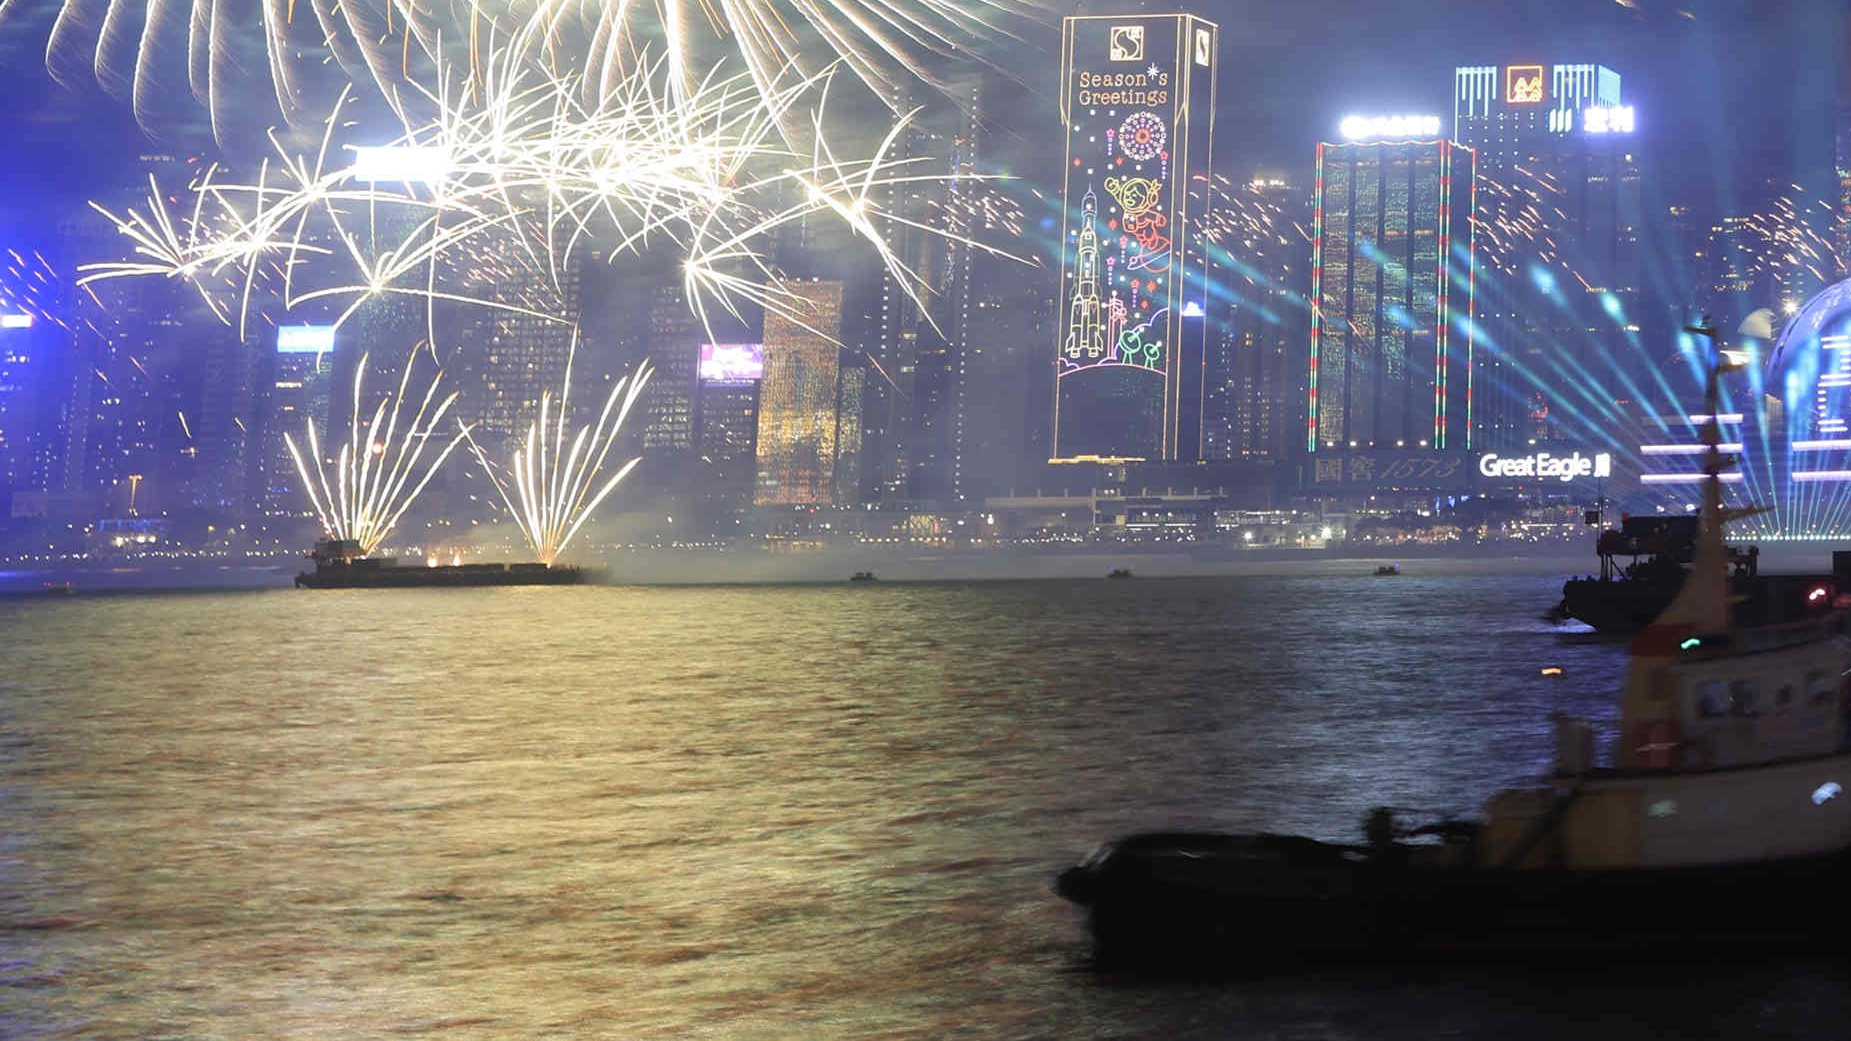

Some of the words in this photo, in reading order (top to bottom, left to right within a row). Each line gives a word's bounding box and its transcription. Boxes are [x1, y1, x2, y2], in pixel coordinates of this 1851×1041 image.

[1079, 68, 1168, 88] Season's
[1079, 89, 1168, 107] Greetings
[1480, 453, 1536, 476] Great
[1536, 452, 1592, 481] Eagle
